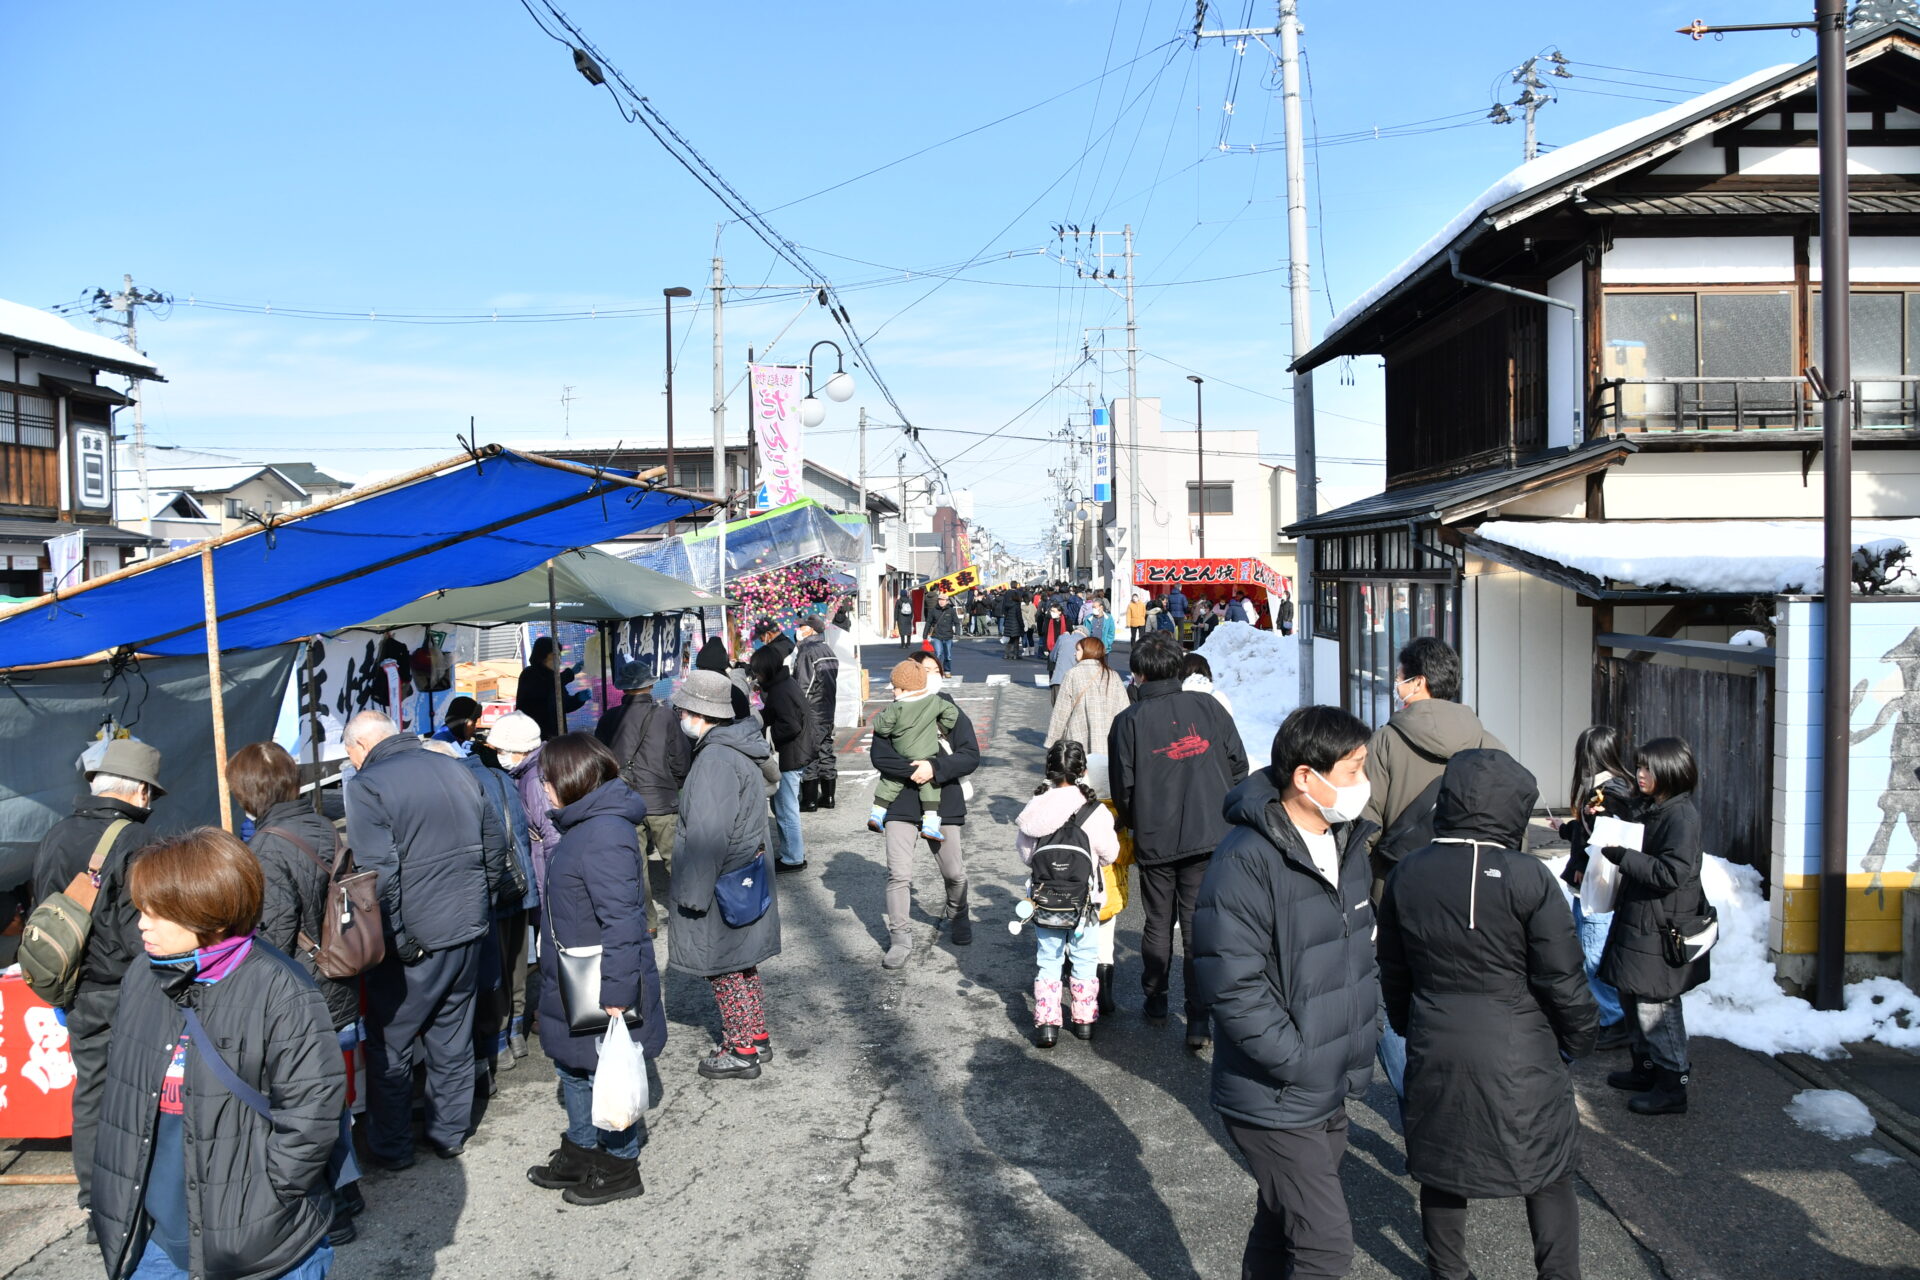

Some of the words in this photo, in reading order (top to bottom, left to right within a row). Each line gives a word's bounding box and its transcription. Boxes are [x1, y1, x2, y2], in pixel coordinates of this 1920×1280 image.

[1097, 432, 1107, 477] 山形新聞
[1148, 565, 1236, 581] どんどん焼
